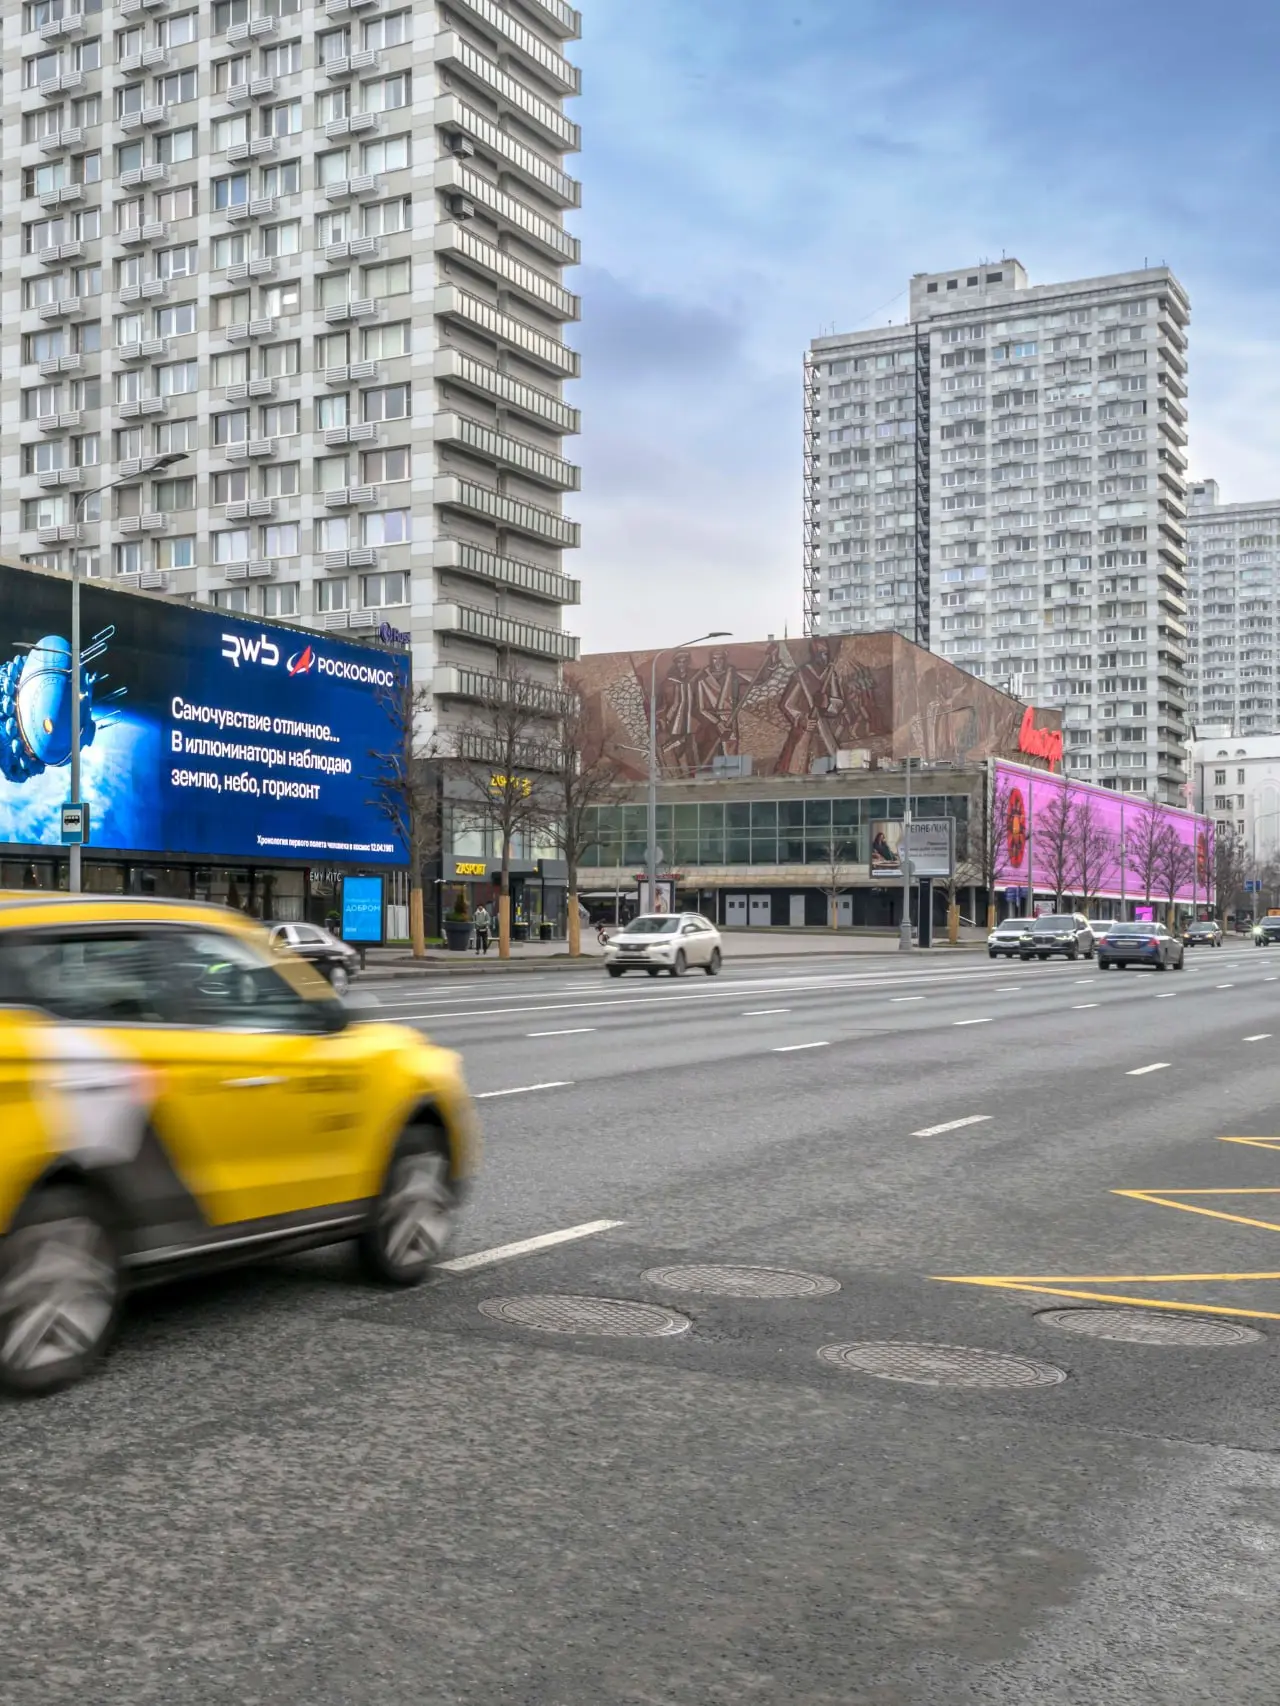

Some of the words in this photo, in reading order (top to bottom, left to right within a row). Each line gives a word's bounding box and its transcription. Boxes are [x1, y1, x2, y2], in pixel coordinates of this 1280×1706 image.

[318, 656, 394, 687] РОСКОСМОС
[172, 696, 271, 730] Самочувствие
[273, 716, 340, 743] отличное...
[171, 730, 182, 752] В
[185, 736, 286, 768] иллюминаторы
[288, 749, 351, 775] наблюдаю
[171, 768, 222, 794] землю,
[224, 771, 260, 797] небо,
[262, 778, 320, 800] горизонт
[455, 863, 487, 876] ZASPORT
